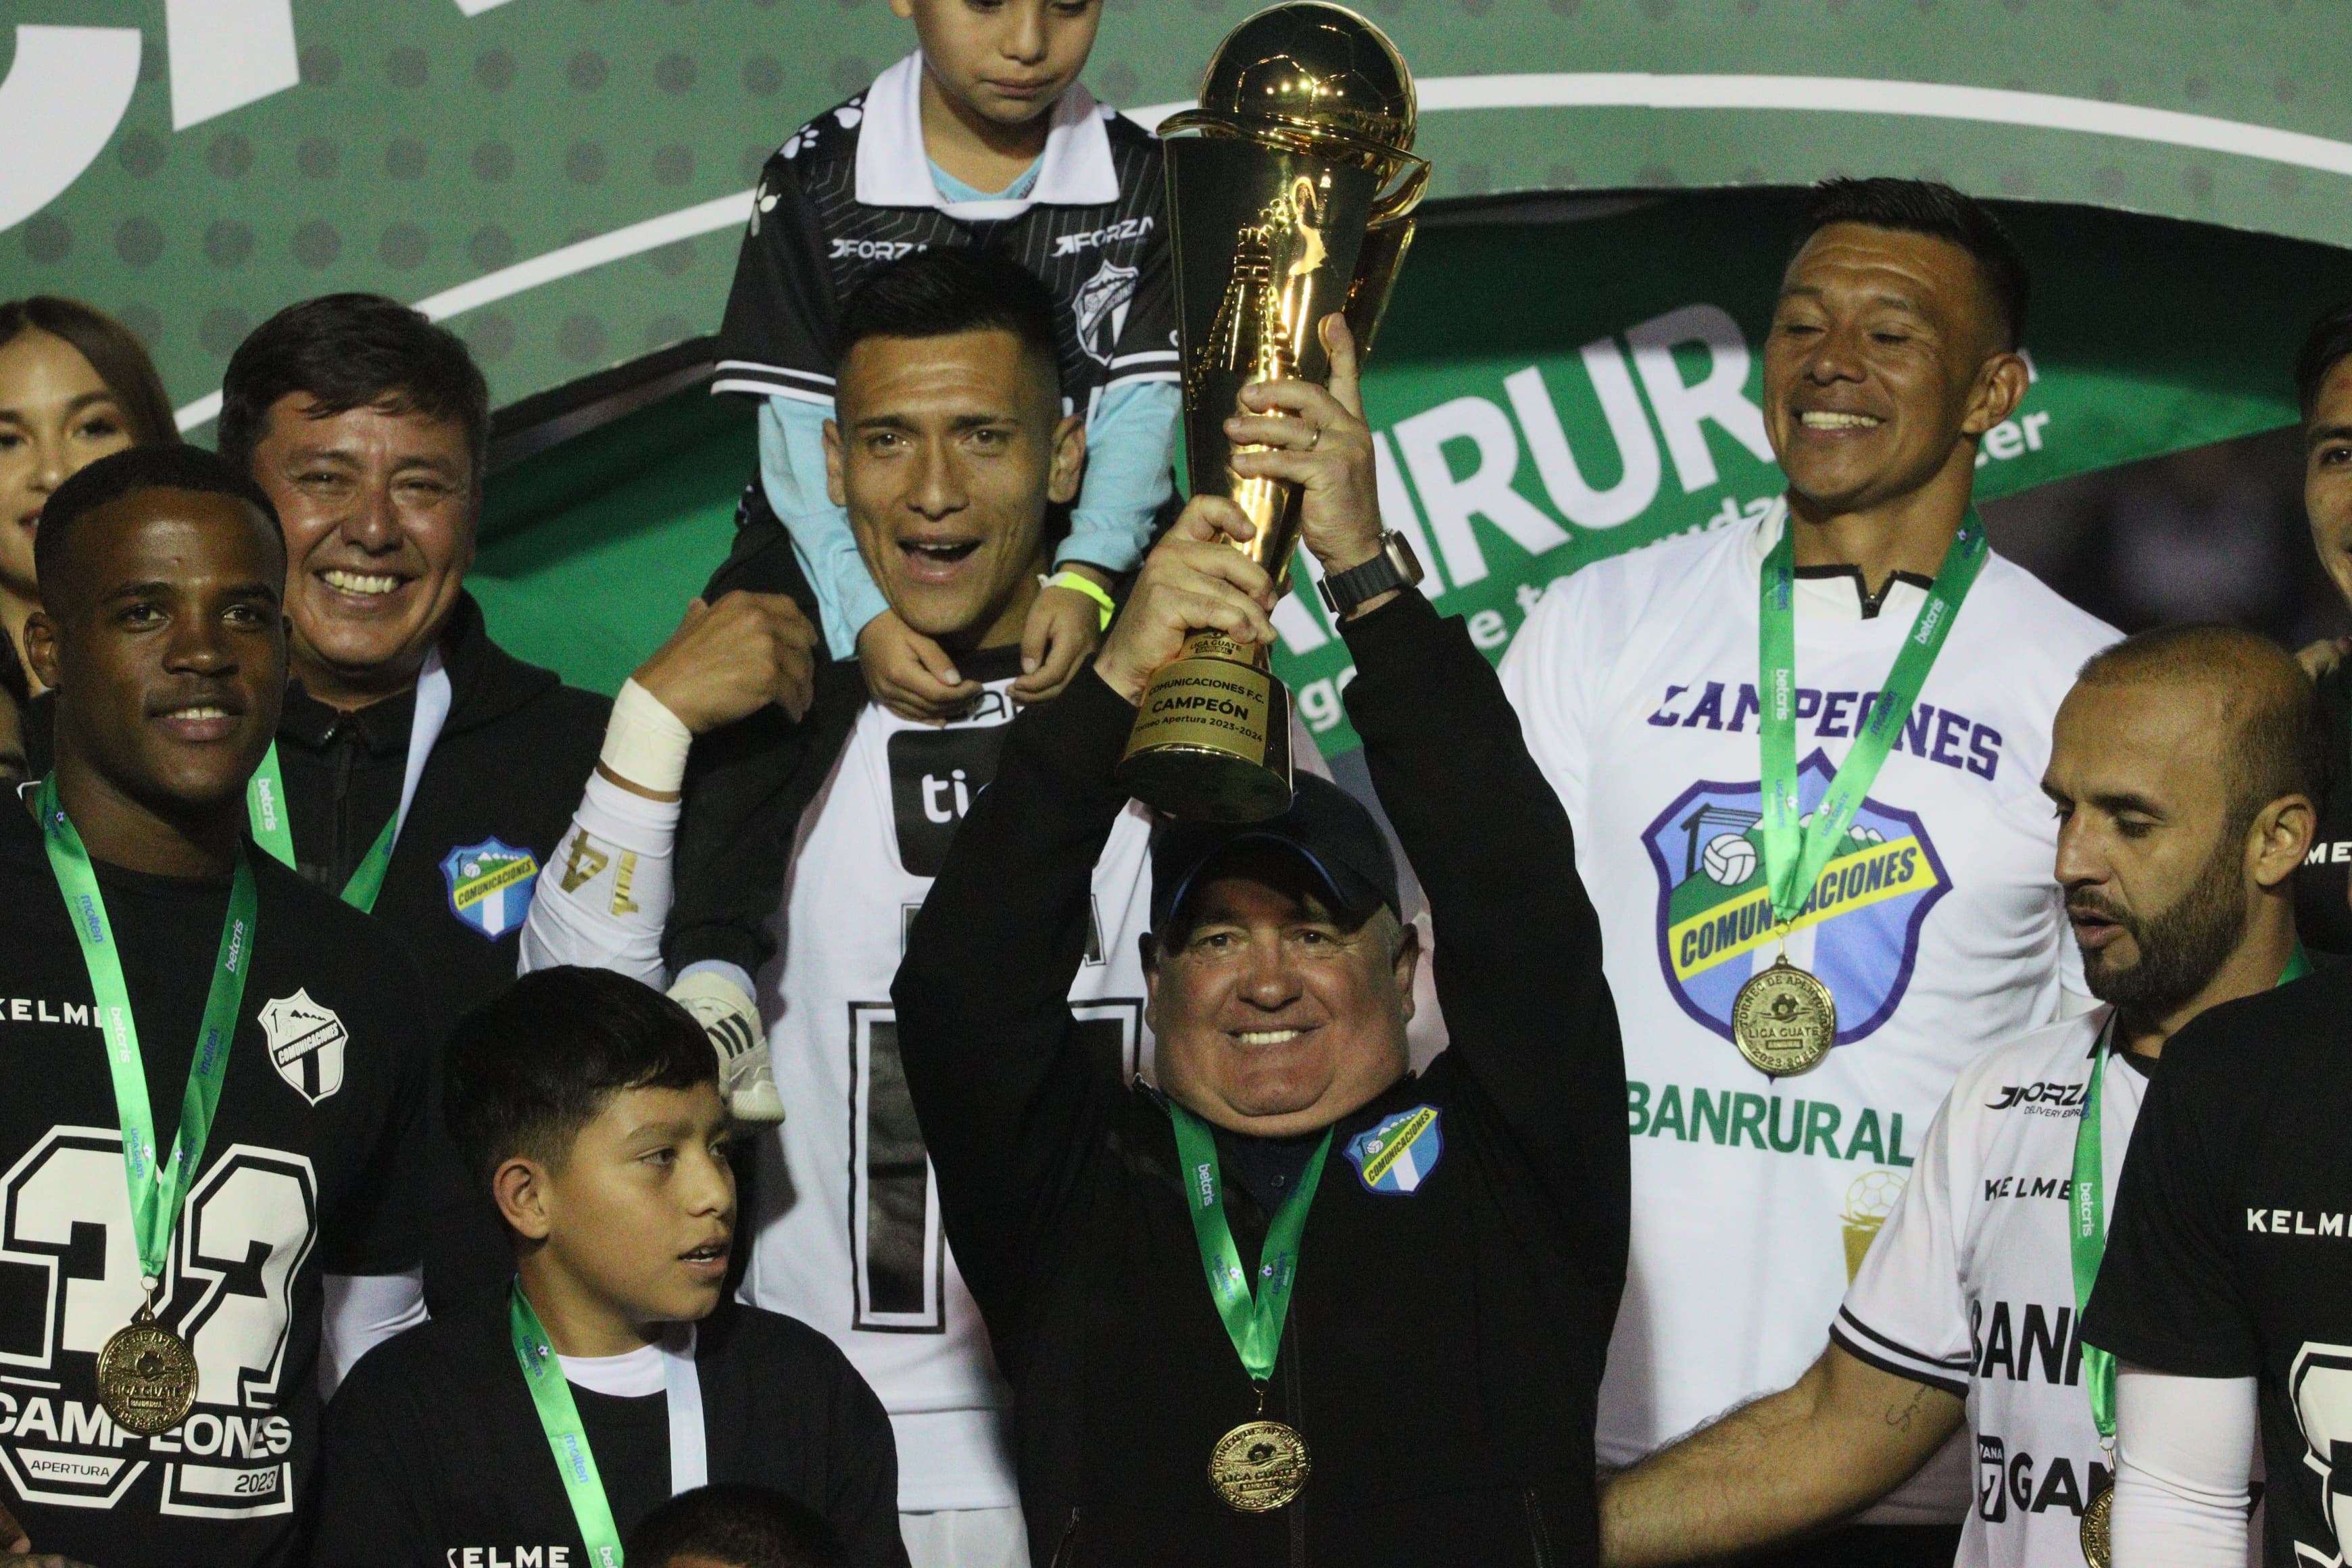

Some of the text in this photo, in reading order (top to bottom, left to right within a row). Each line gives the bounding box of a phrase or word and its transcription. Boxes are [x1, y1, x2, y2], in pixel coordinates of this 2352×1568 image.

[1914, 598, 1945, 645] betcris
[1149, 677, 1265, 704] COMUNICACIONES F.C.
[1152, 696, 1248, 720] CAMPEÓN
[1775, 668, 1790, 721] betcris
[1162, 715, 1206, 725] Apertura
[1210, 718, 1263, 742] 2023-2024
[258, 778, 278, 831] betcris
[458, 860, 532, 906] COMUNICACIONES
[80, 893, 105, 944] molten
[1680, 846, 1917, 969] COMUNACIONES
[225, 918, 244, 973] betcris
[110, 1006, 130, 1064] betcris
[278, 1022, 339, 1065] COMUNICACIONES
[1748, 1026, 1819, 1038] LIGA GUATE
[1368, 1109, 1431, 1182] COMUNICACIONES
[1626, 1079, 1915, 1168] BANRURAL
[1198, 1163, 1215, 1206] betcris
[2080, 1181, 2094, 1238] betcris
[2247, 1208, 2352, 1238] KELM
[30, 1459, 110, 1477] APERTURA
[234, 1470, 276, 1494] 2023
